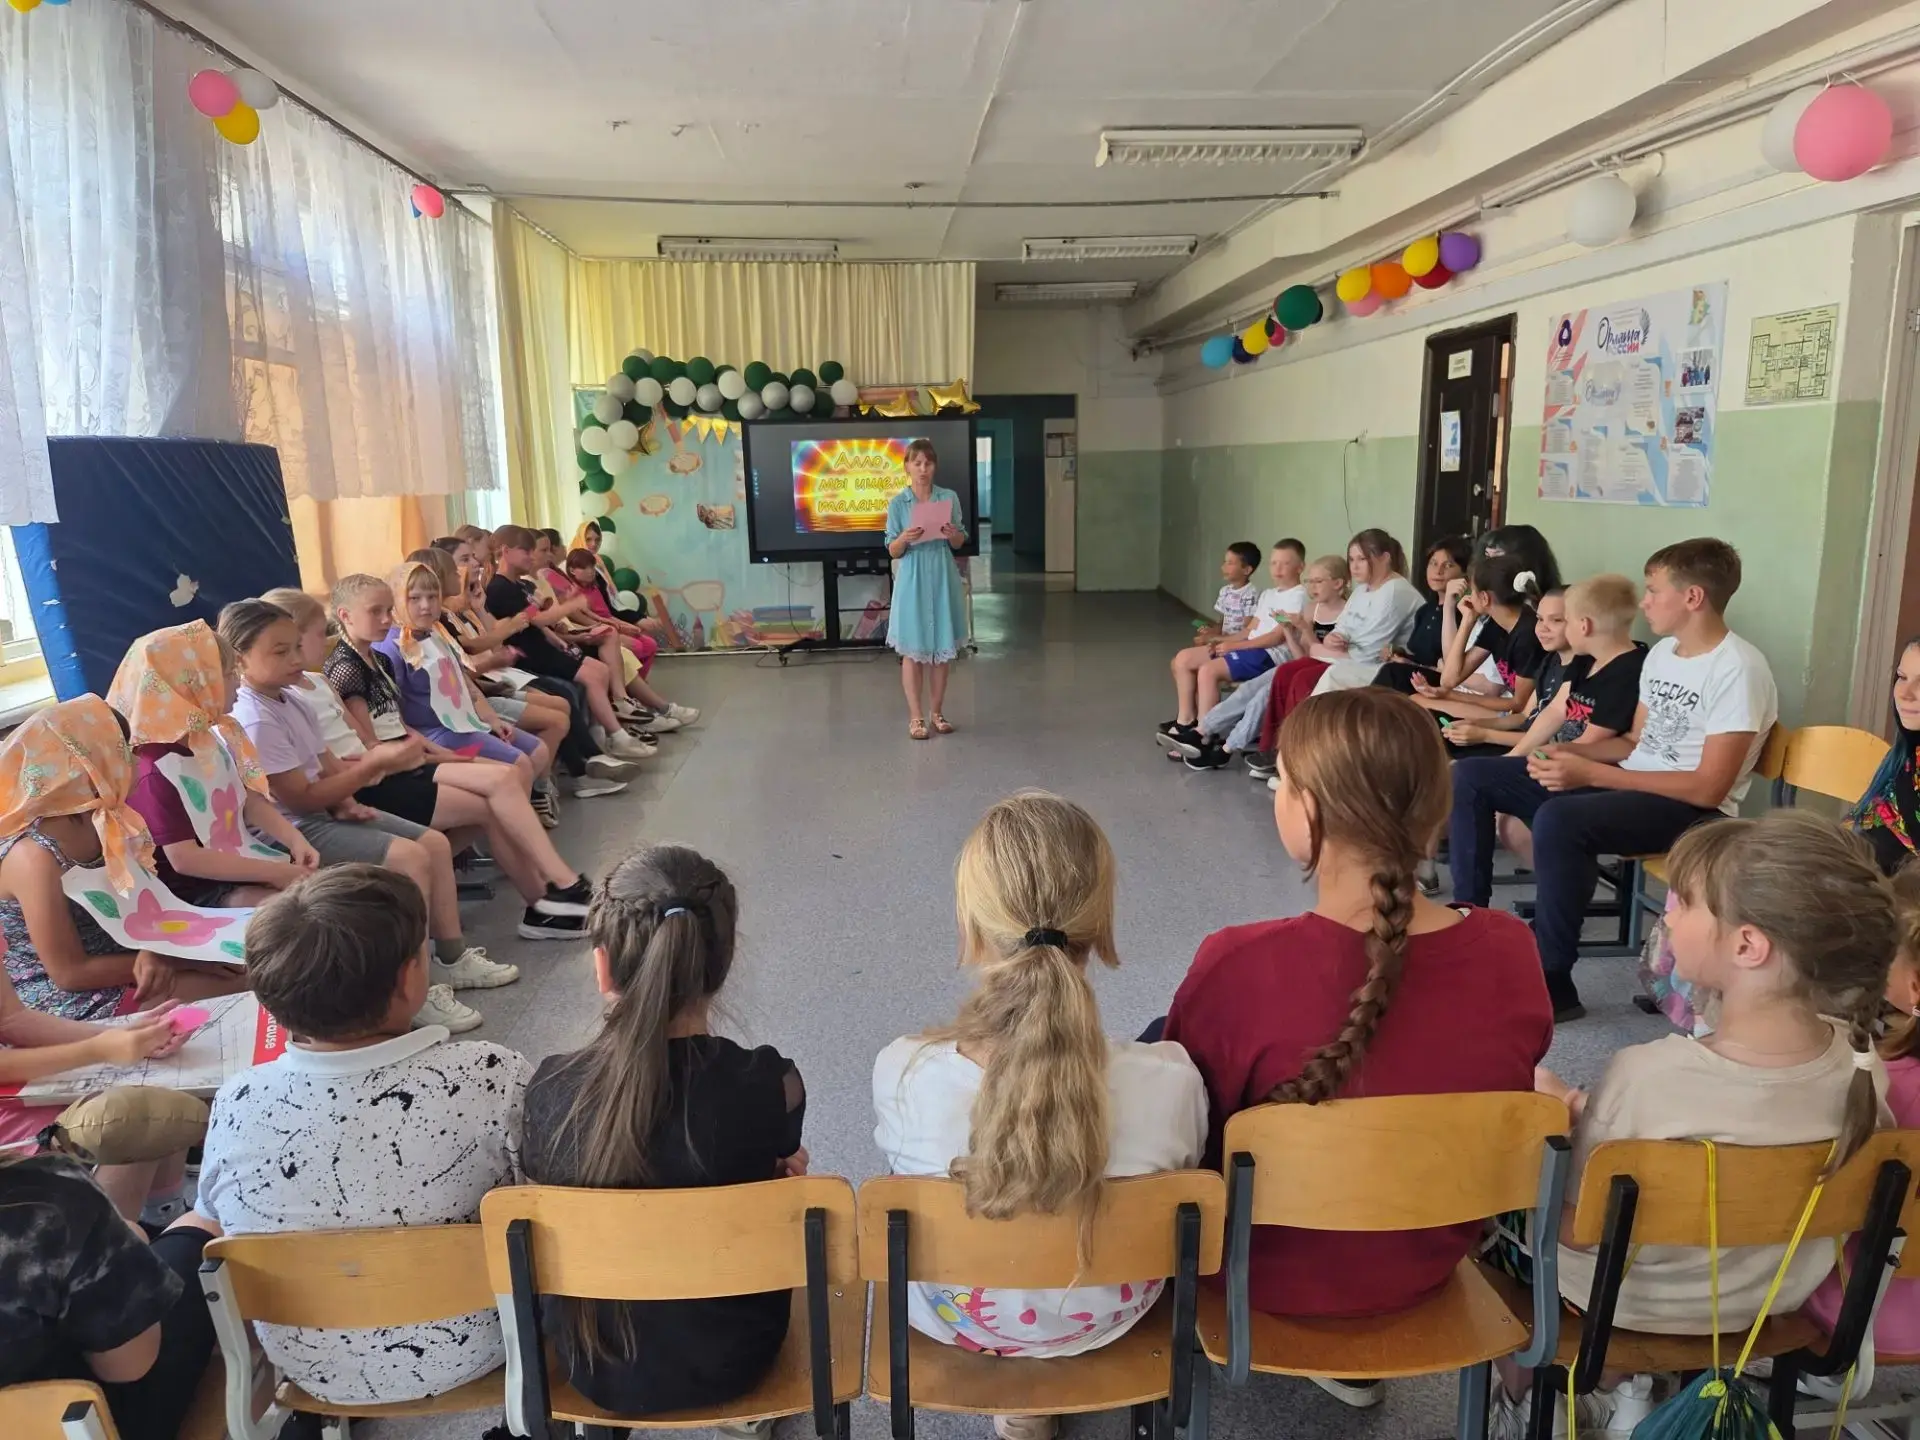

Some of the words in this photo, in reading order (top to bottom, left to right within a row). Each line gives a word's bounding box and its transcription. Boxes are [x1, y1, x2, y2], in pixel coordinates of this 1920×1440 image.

[834, 451, 890, 470] Алло,
[819, 478, 848, 492] мы
[854, 474, 907, 492] ищем
[818, 498, 889, 512] талант
[1649, 680, 1700, 711] ОССИЯ
